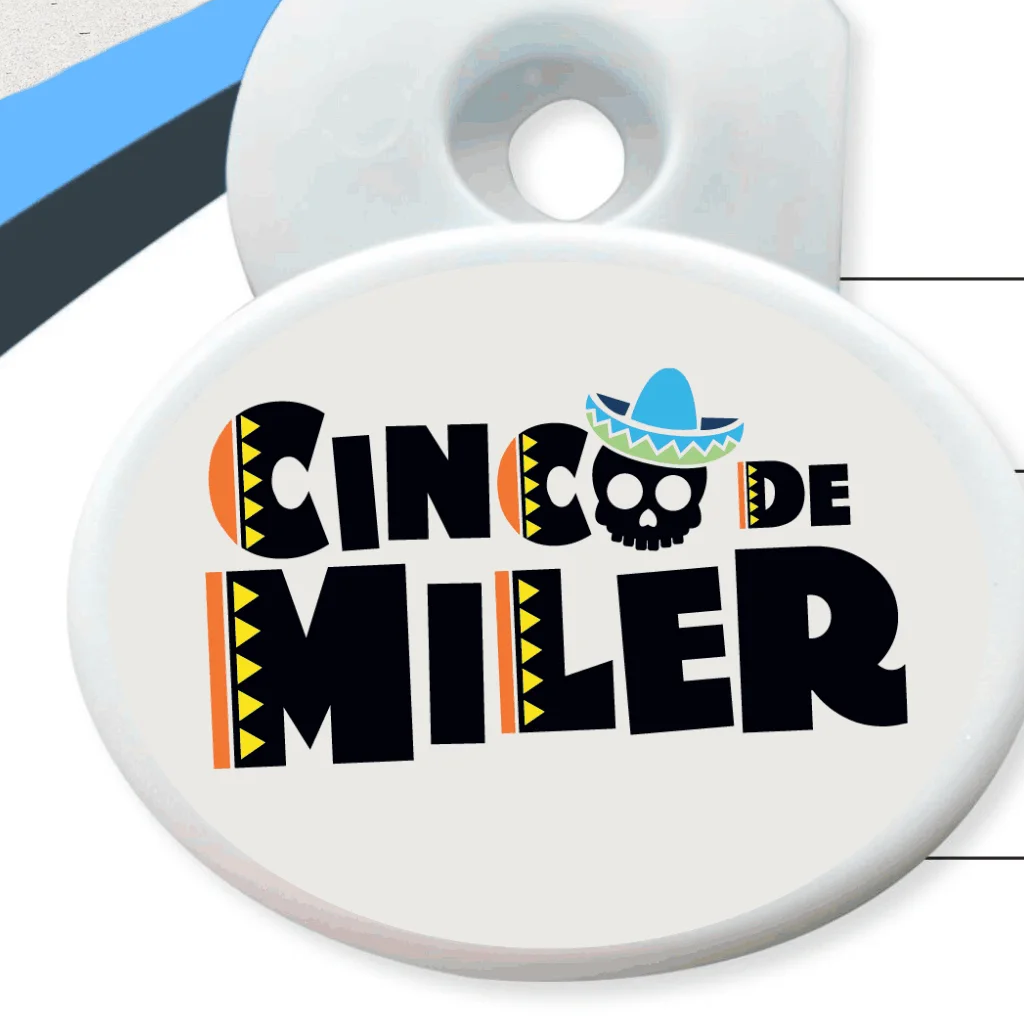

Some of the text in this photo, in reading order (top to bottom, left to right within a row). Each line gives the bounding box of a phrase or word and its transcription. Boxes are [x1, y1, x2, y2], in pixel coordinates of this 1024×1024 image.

[208, 368, 851, 560] CINCO DE
[205, 546, 908, 769] MILER
